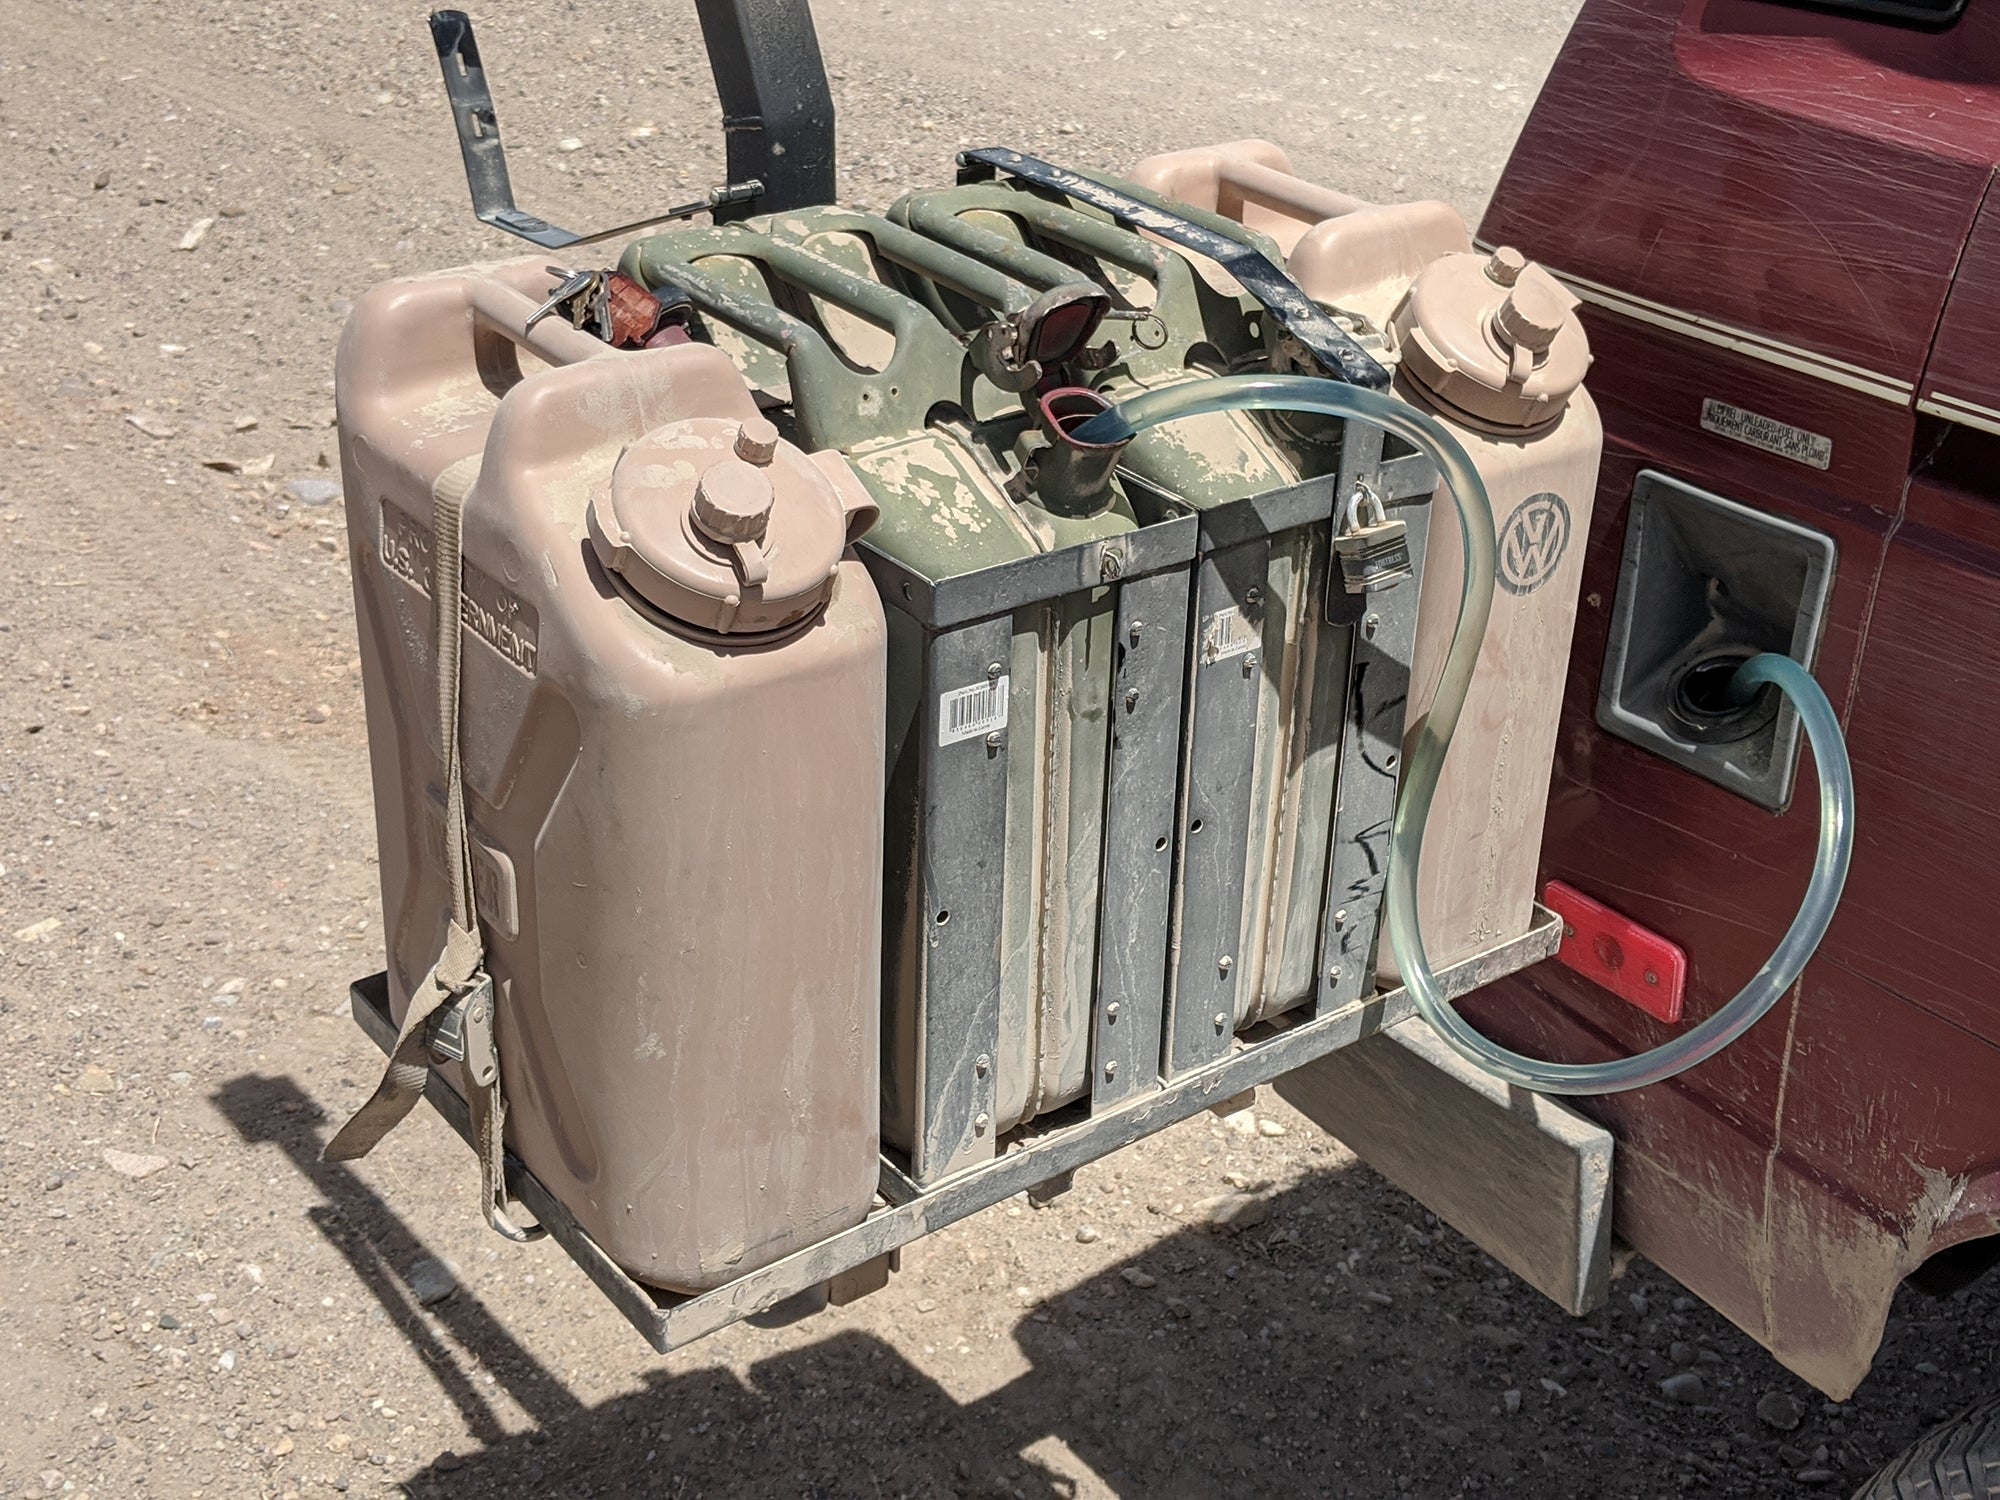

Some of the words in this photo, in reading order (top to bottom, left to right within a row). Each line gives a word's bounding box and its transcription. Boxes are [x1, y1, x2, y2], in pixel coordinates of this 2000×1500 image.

[1740, 412, 1777, 433] UNLEADED
[1778, 425, 1794, 440] FUEL
[1797, 432, 1816, 446] ONLY
[1744, 424, 1782, 446] CARBURANT
[1784, 438, 1800, 453] SANS
[1802, 445, 1825, 461] PLOMB
[383, 533, 414, 578] U.S.
[1500, 500, 1566, 587] VW
